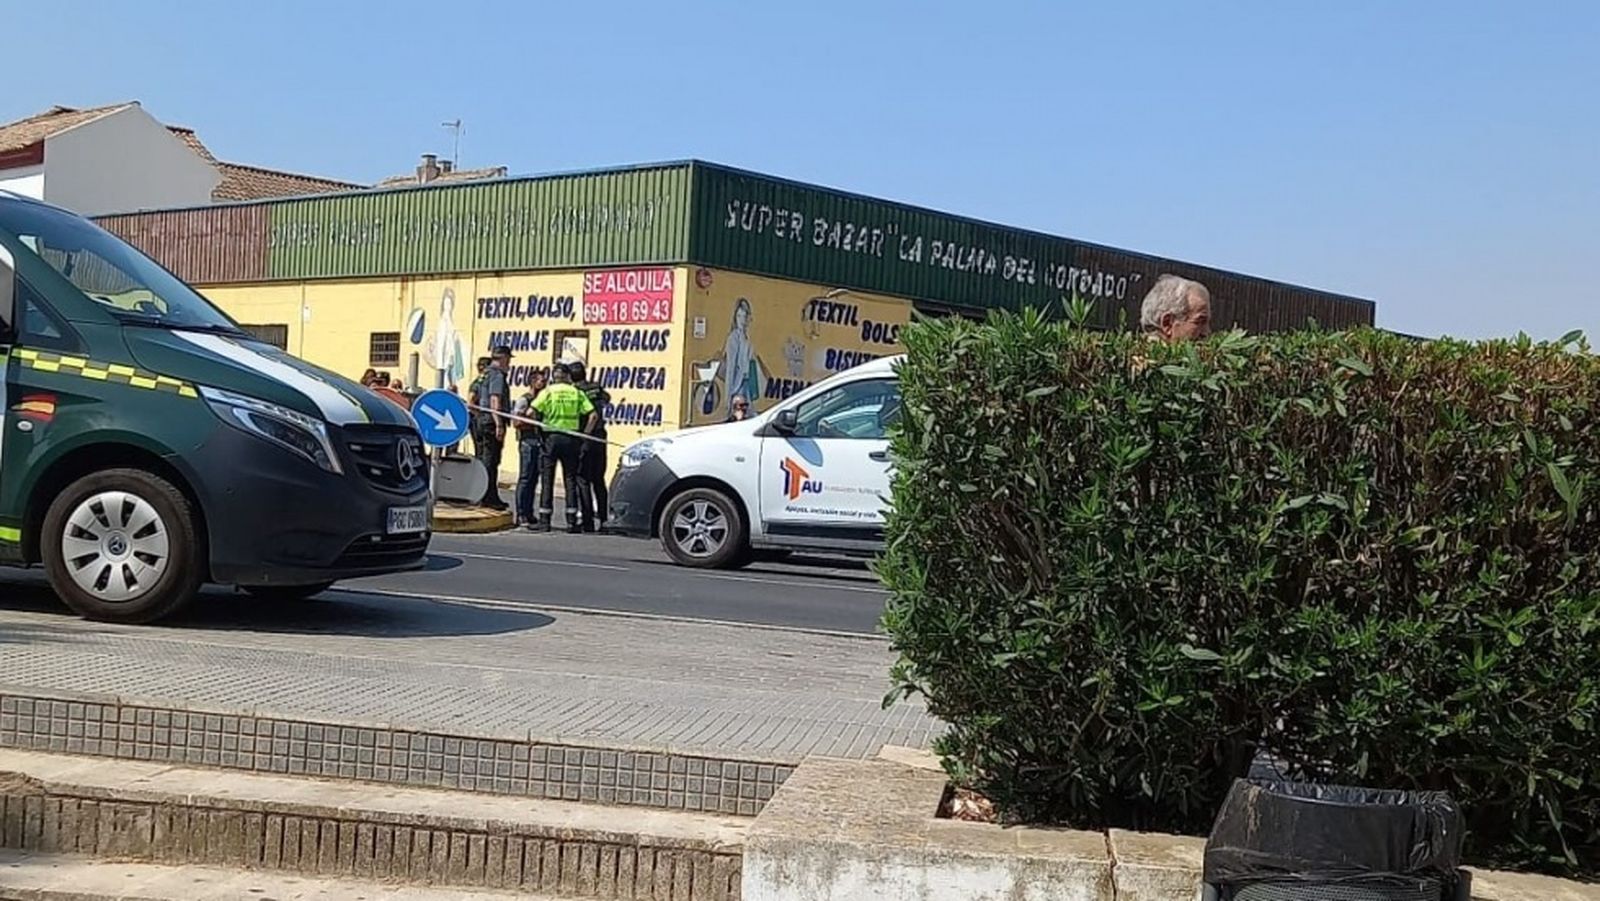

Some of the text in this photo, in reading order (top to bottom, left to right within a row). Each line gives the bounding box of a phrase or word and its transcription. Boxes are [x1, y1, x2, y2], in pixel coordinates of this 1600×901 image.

[725, 200, 804, 242] SUPER
[812, 217, 884, 257] BAZAR
[929, 240, 997, 275] PALMA
[1002, 255, 1036, 285] DEL
[584, 271, 672, 293] SE ALQUILA
[584, 300, 670, 322] 696 18 69 43
[808, 299, 900, 345] TEXTIL BOLS
[488, 330, 549, 352] MENAJE
[600, 329, 670, 352] REGALOS
[588, 366, 666, 391] LIMPIEZA
[764, 376, 812, 400] MEN
